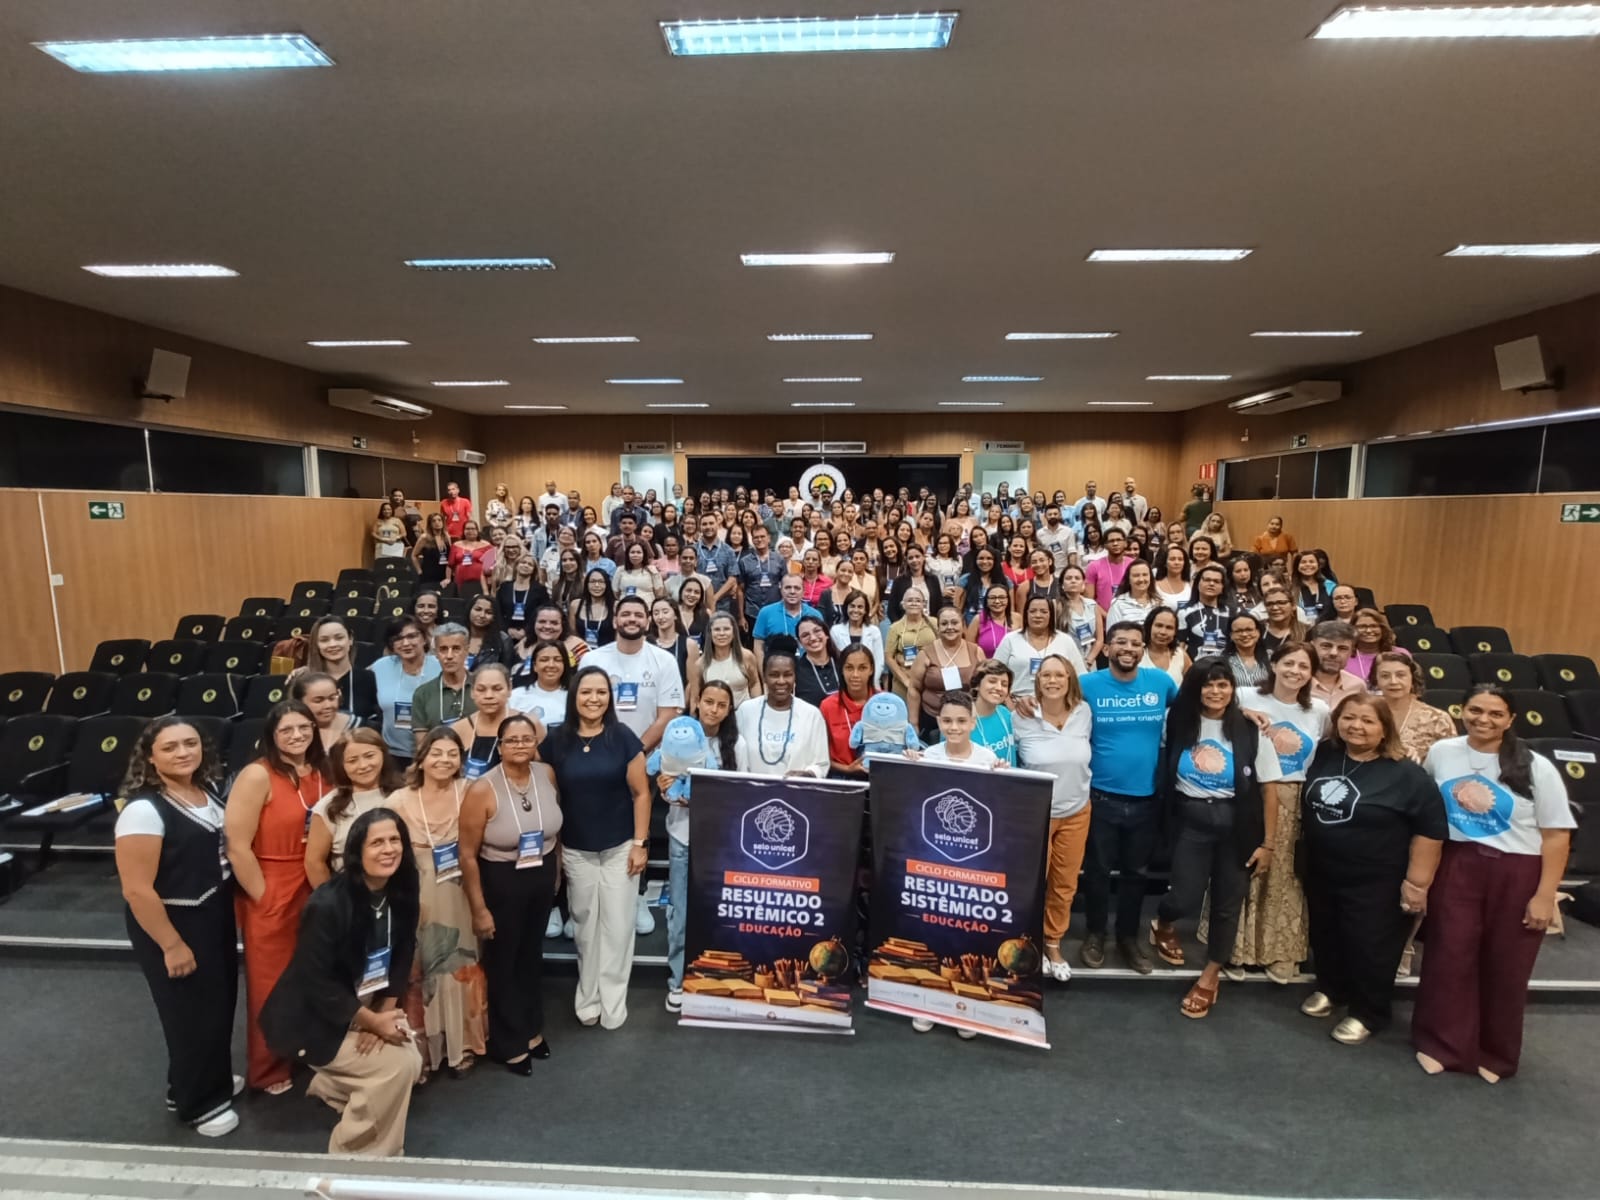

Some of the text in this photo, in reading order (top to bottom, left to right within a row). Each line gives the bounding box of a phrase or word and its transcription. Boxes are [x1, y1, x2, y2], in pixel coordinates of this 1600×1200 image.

[1096, 693, 1142, 708] unicef
[770, 844, 796, 853] unicef
[934, 833, 952, 842] selo
[952, 836, 979, 845] unicef
[733, 874, 812, 889] CICLO FORMATIVO
[915, 864, 998, 884] CICLO FORMATIVO
[721, 887, 822, 909] RESULTADO
[904, 875, 1009, 905] RESULTADO
[717, 903, 825, 927] SISTÊMICO 2
[900, 891, 1013, 923] SISTÊMICO 2
[738, 922, 802, 938] EDUCAÇÃO
[922, 913, 989, 933] EDUCAÇÃO
